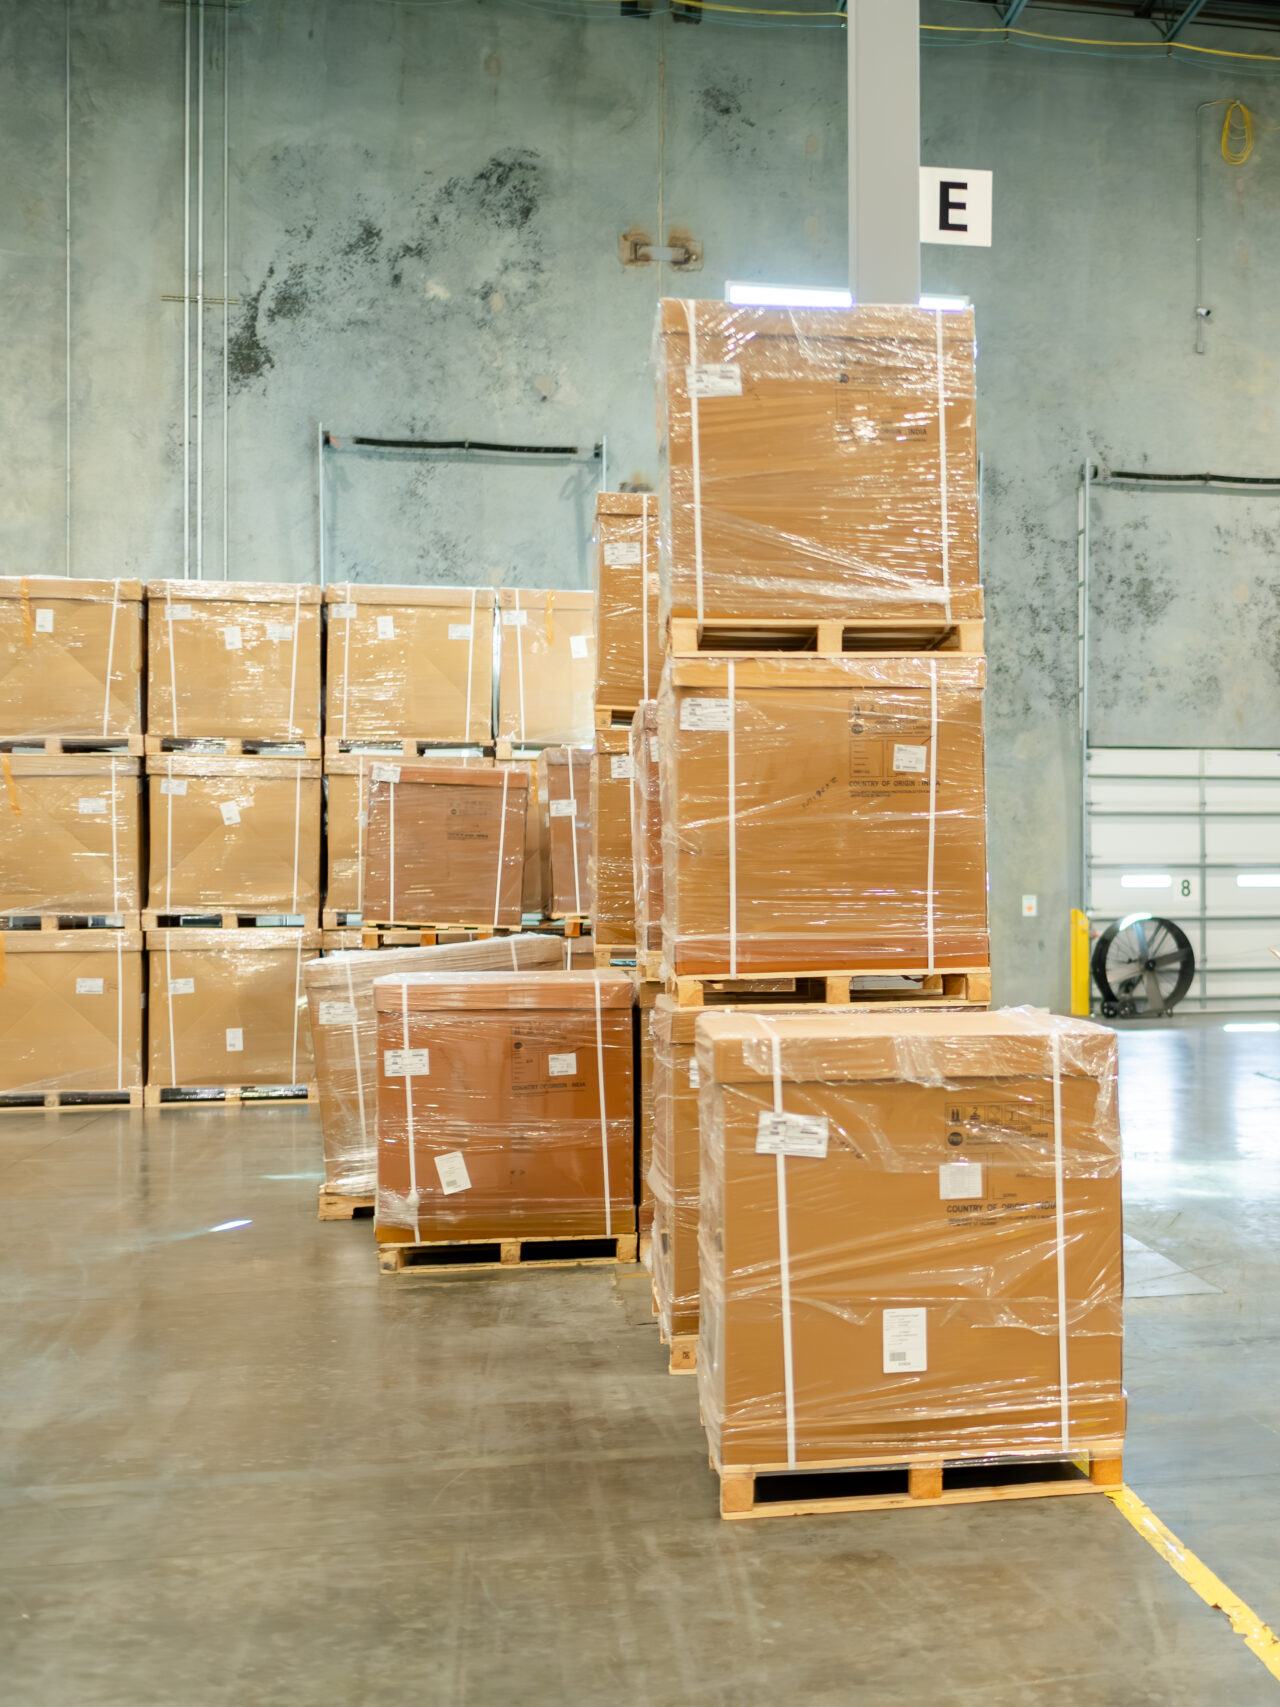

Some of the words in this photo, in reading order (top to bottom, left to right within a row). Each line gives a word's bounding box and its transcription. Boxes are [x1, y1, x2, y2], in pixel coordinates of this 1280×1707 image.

[939, 181, 968, 232] E
[1181, 879, 1191, 897] 8
[946, 1204, 983, 1213] COUNTRY
[987, 1203, 997, 1211] OF
